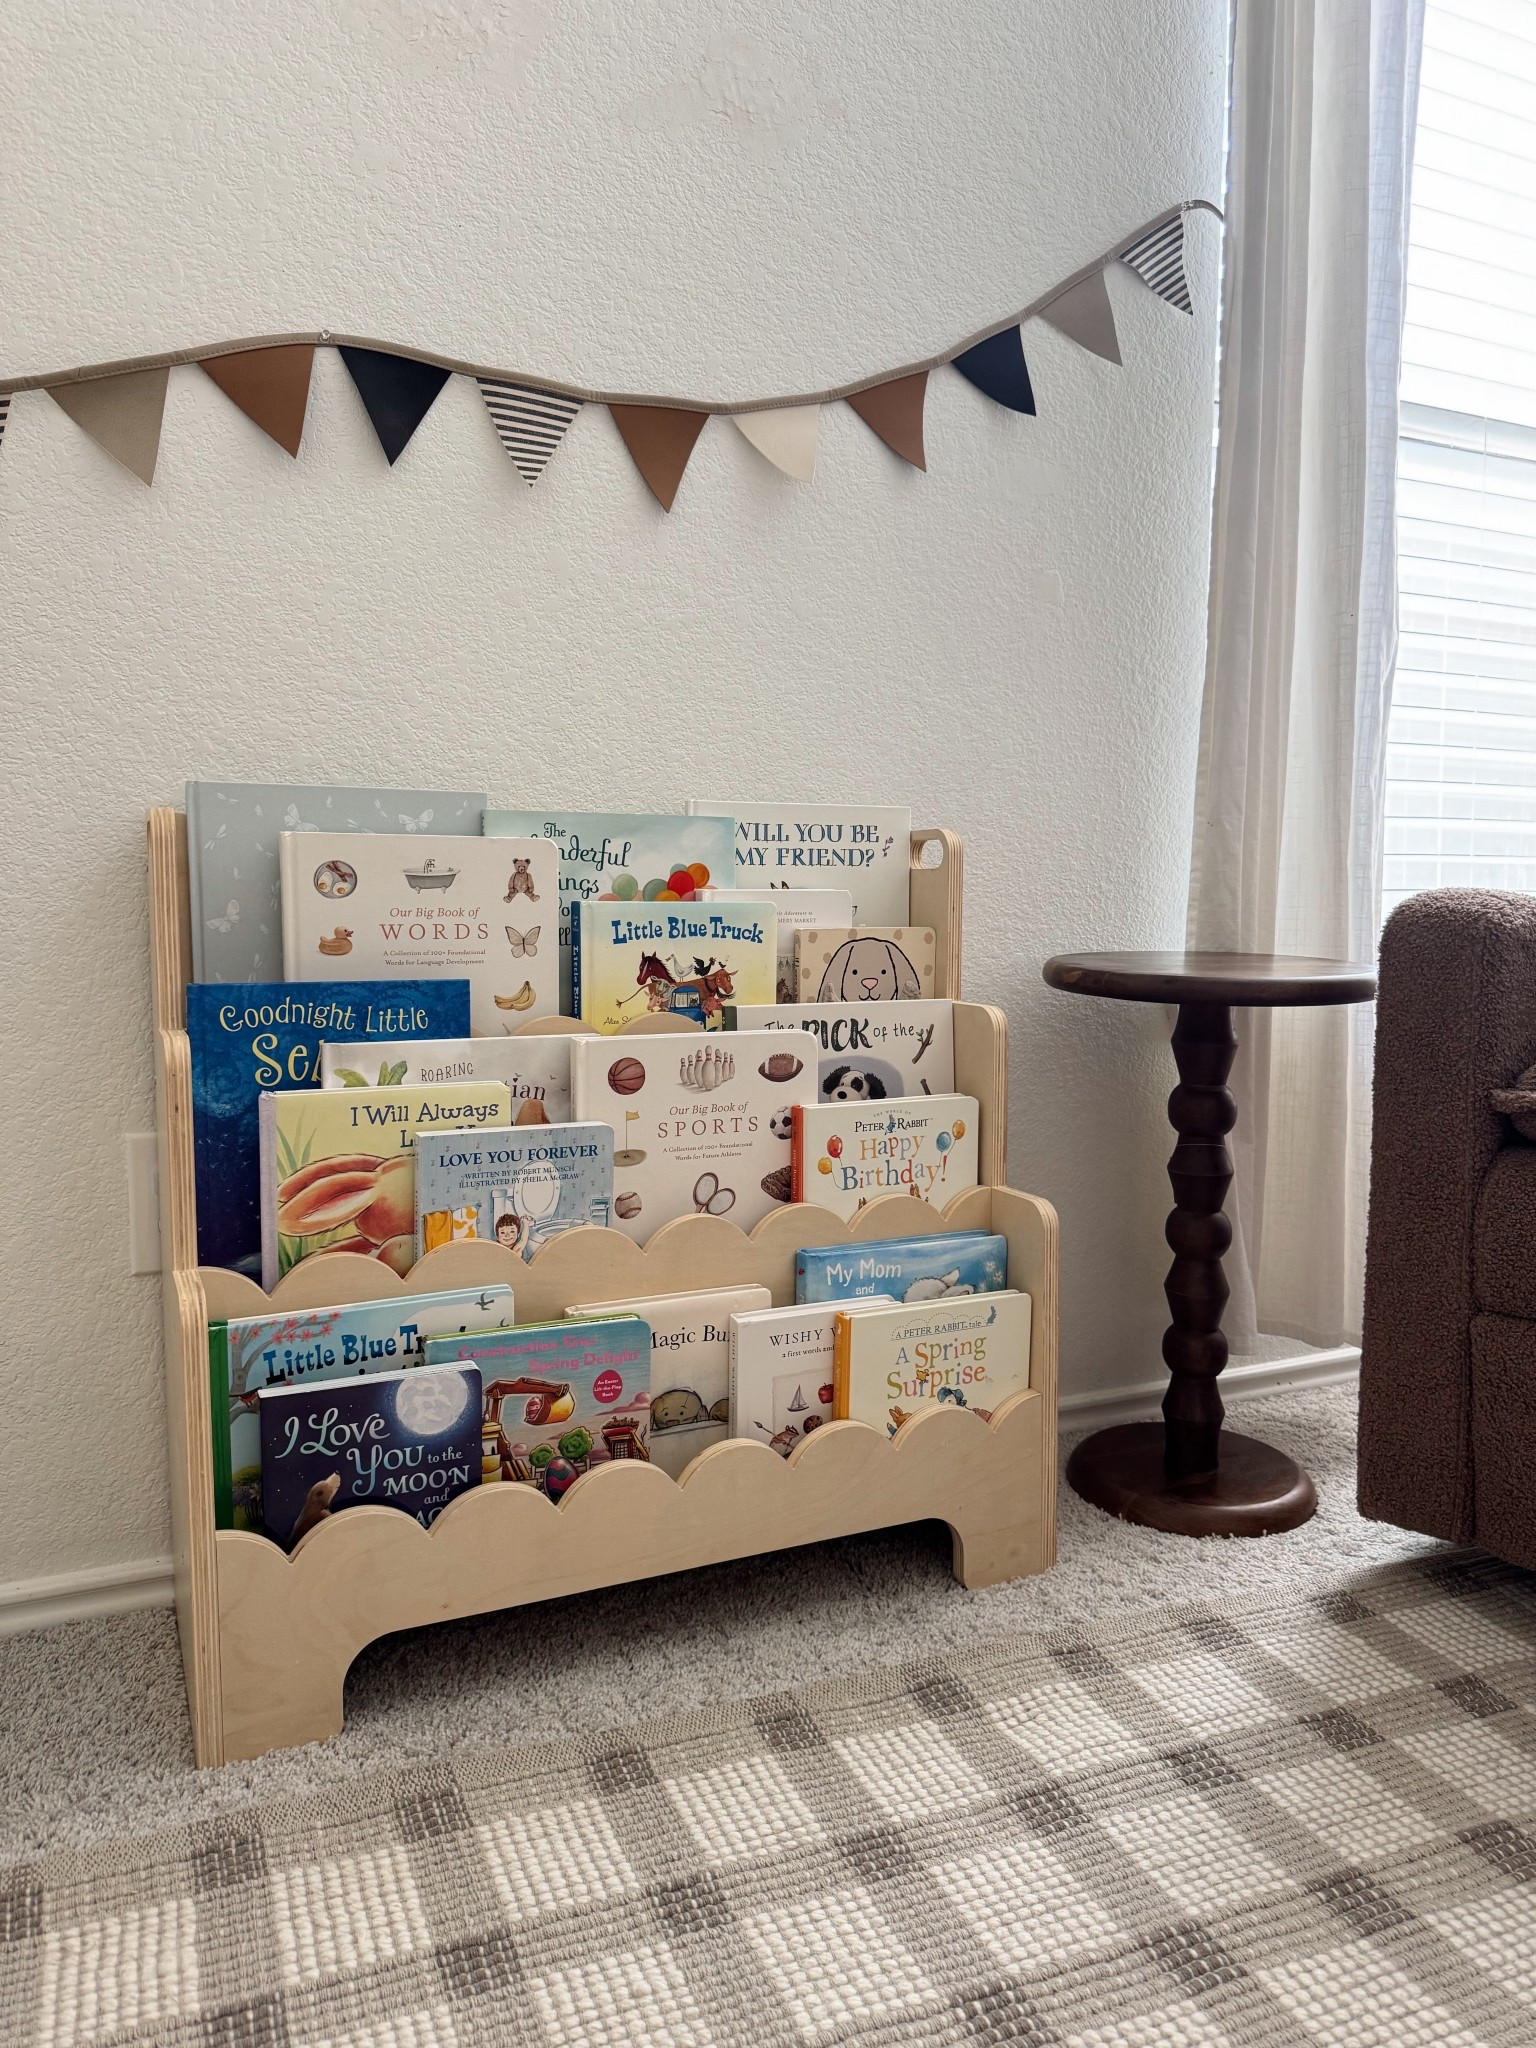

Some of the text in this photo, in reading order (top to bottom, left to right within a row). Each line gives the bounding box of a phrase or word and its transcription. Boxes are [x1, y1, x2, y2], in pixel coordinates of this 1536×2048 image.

[544, 823, 566, 838] The
[735, 822, 879, 843] WILL YOU BE
[557, 835, 631, 871] nderful
[735, 847, 875, 867] MY FRIEND?
[558, 874, 599, 899] ings
[390, 907, 480, 919] Our Big Book of
[379, 923, 488, 940] WORDS
[611, 916, 763, 944] Little Blue Truck
[417, 959, 444, 967] Language
[446, 958, 484, 966] Development
[219, 997, 429, 1033] Goodnight Little
[802, 1018, 873, 1052] PICK
[873, 1026, 888, 1042] of
[893, 1022, 915, 1037] the
[252, 1033, 324, 1087] Se
[421, 1062, 474, 1081] ROARING
[351, 1102, 499, 1126] I Will Always
[669, 1101, 749, 1116] Our Big Book of
[657, 1116, 759, 1138] SPORTS
[854, 1117, 929, 1133] PETER RABBIT
[439, 1144, 599, 1168] LOVE YOU FOREVER
[668, 1145, 697, 1153] Collection
[719, 1141, 753, 1150] Foundational
[702, 1152, 720, 1160] Future
[720, 1150, 741, 1158] Athletes
[860, 1135, 925, 1160] Happy
[459, 1178, 510, 1188] ILLUSTRATED
[522, 1175, 548, 1184] SHEILA
[550, 1173, 580, 1182] McGRAW
[465, 1165, 575, 1180] WRITTEN BY ROBERT MUNSCH
[841, 1155, 948, 1192] Birthday!
[826, 1257, 902, 1287] My Mom
[855, 1283, 875, 1295] and
[703, 1324, 730, 1342] Bu
[769, 1328, 823, 1347] WISHY
[895, 1320, 982, 1339] A PETER RABBIT tale
[263, 1344, 336, 1385] Little
[341, 1334, 397, 1365] Blue
[457, 1339, 558, 1360] Construction
[787, 1350, 801, 1358] first
[803, 1346, 821, 1355] words
[895, 1336, 987, 1369] A Spring
[528, 1349, 640, 1373] Spring Delight
[887, 1362, 986, 1400] Surprise
[274, 1416, 300, 1459] I
[427, 1453, 440, 1463] to
[442, 1446, 464, 1462] the
[383, 1464, 470, 1496] MOON
[424, 1487, 450, 1504] and
[416, 1507, 444, 1528] AC
